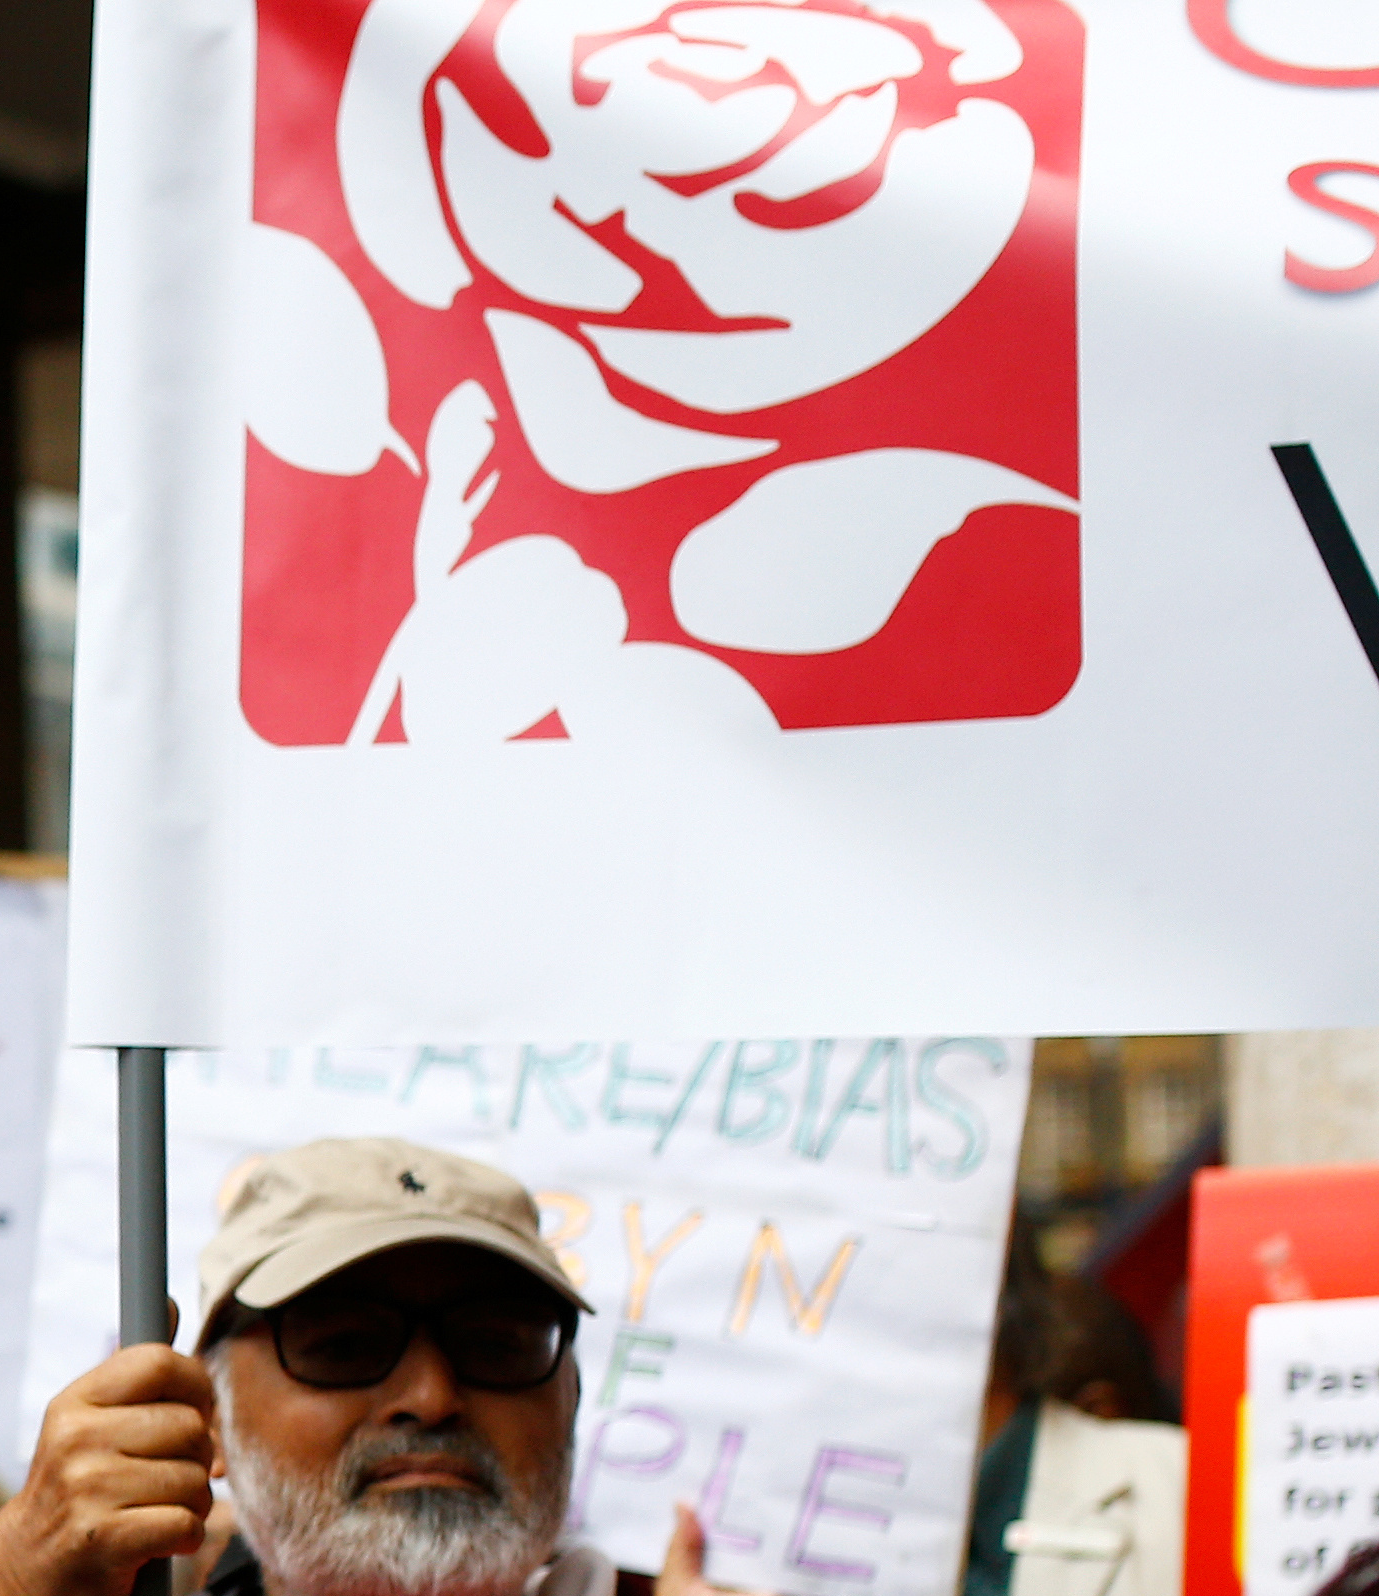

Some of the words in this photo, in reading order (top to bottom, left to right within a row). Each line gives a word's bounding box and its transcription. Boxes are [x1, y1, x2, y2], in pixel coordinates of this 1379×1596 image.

[1284, 1364, 1379, 1396] Pas
[565, 1402, 905, 1582] PLE
[1284, 1487, 1349, 1516] for
[1283, 1542, 1329, 1574] of
